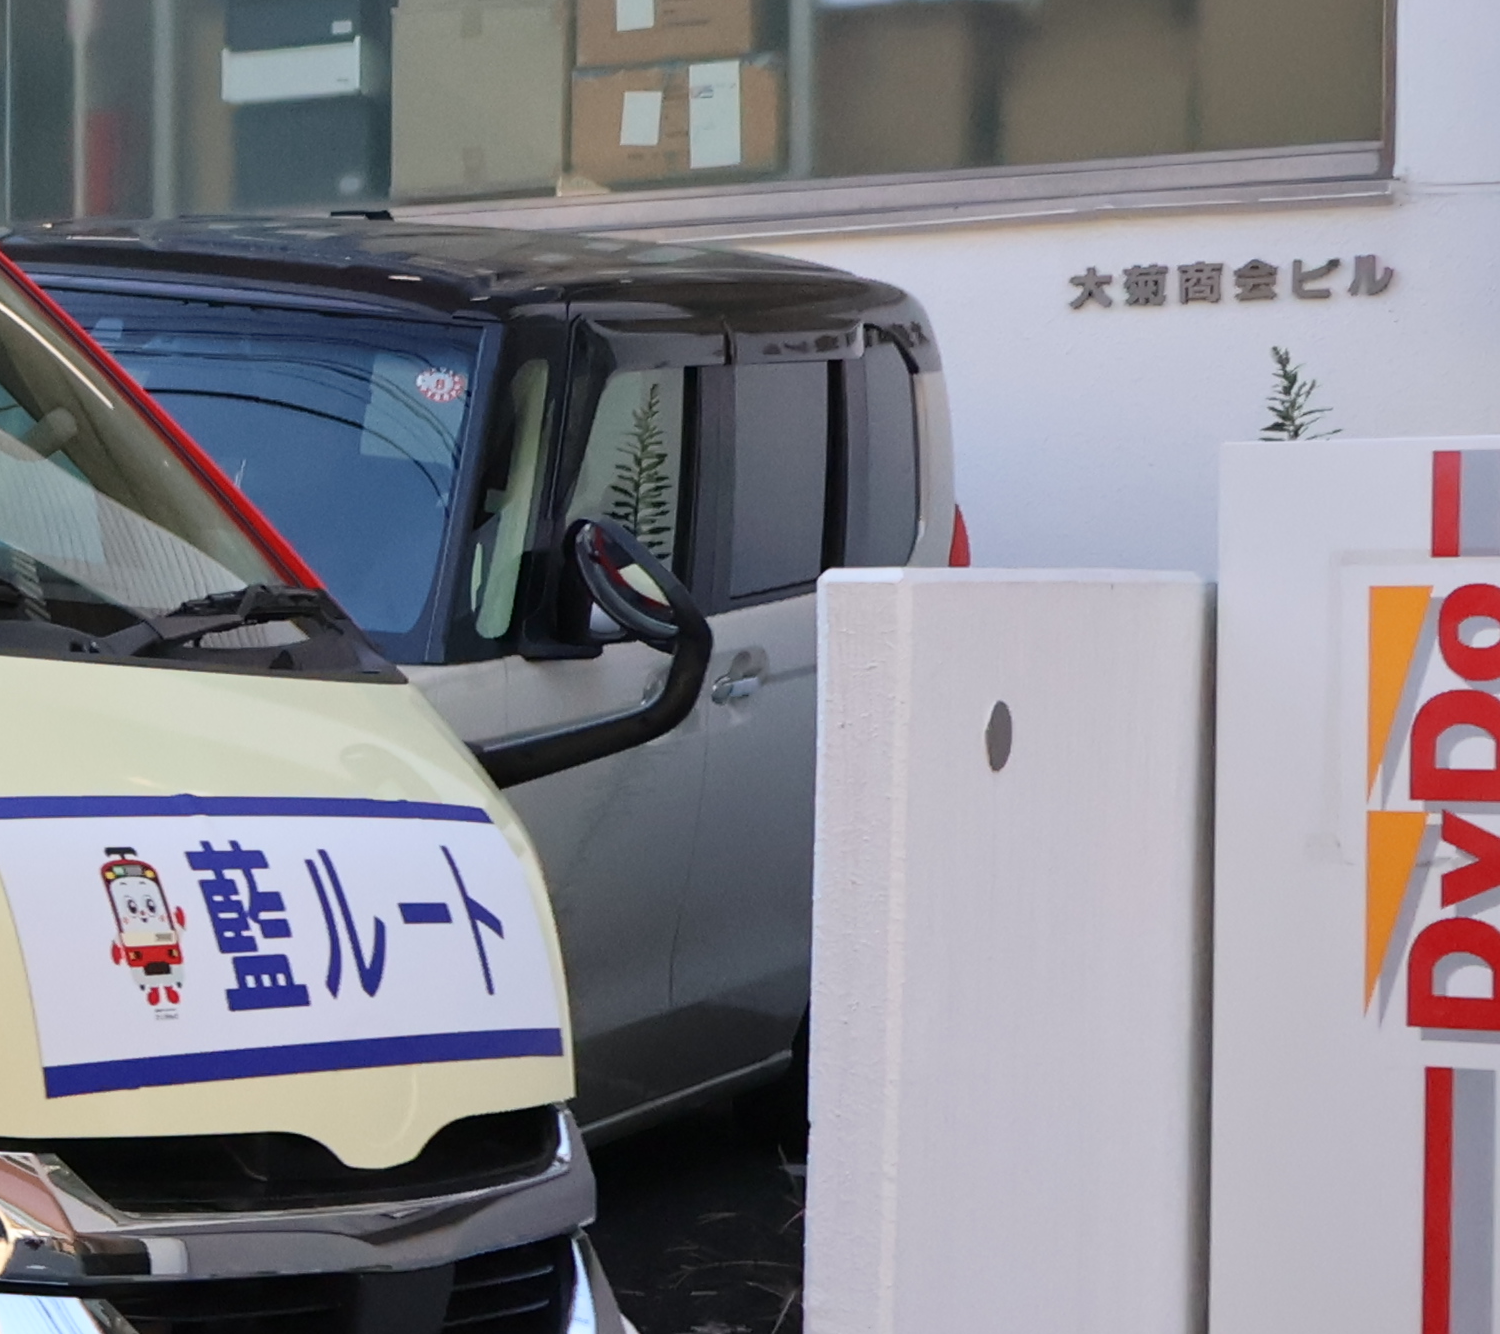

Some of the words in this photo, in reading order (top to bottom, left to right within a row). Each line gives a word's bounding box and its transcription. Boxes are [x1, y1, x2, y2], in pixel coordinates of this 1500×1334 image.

[1068, 254, 1395, 310] 大菊商会ビル
[183, 839, 505, 1012] 藍ルート
